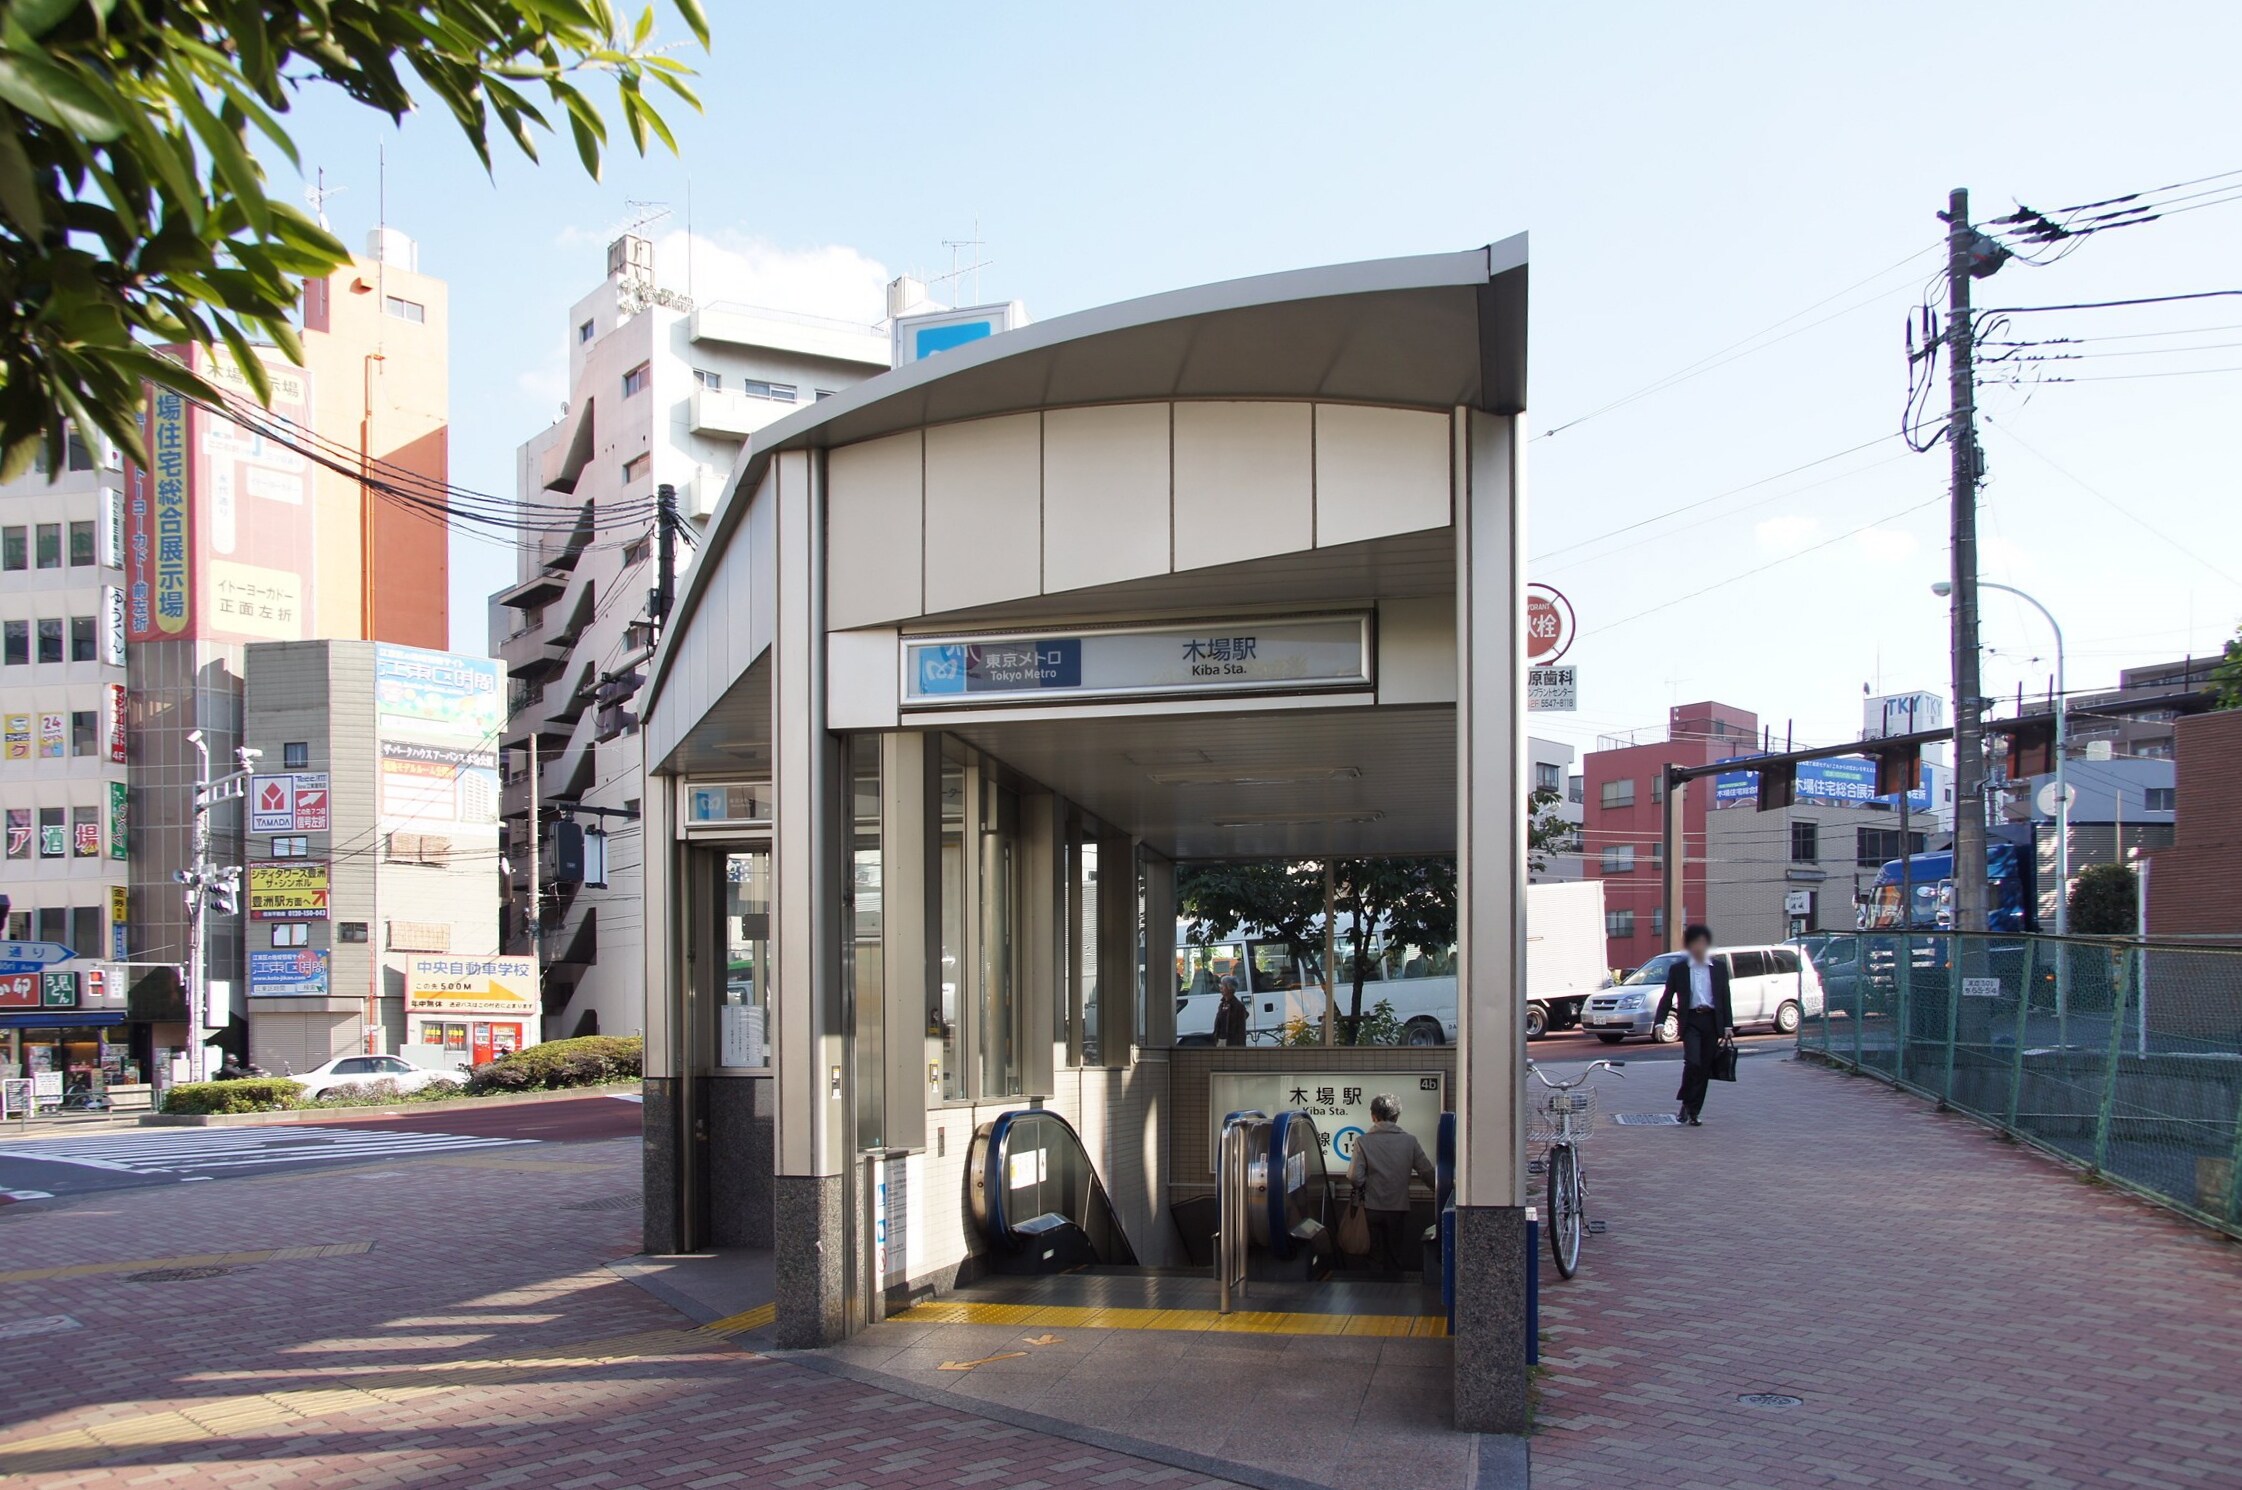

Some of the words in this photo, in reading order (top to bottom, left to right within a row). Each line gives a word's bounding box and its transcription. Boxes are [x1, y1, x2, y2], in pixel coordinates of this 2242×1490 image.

[207, 364, 299, 398] 木場示場
[156, 394, 185, 617] 場住宅総合展示場
[213, 579, 294, 601] イトーヨーカドー
[219, 598, 293, 622] 正面左折
[1182, 637, 1257, 662] 木場駅
[985, 651, 1062, 669] 東京メトロ
[990, 670, 1022, 682] Tokyo
[1025, 669, 1057, 680] Metro
[1192, 664, 1220, 676] Kiba
[1224, 663, 1247, 675] Sta.
[1887, 695, 1921, 716] TKY
[43, 716, 62, 729] 24
[256, 818, 290, 827] YAMADA
[297, 816, 326, 829] 信号左折
[252, 895, 311, 908] 豊洲駅方面へ
[417, 960, 530, 977] 中央自動車学校
[441, 982, 472, 990] 500M
[1421, 1078, 1437, 1090] 4b
[1289, 1087, 1362, 1105] 木場駅
[1329, 1106, 1349, 1116] Sta.
